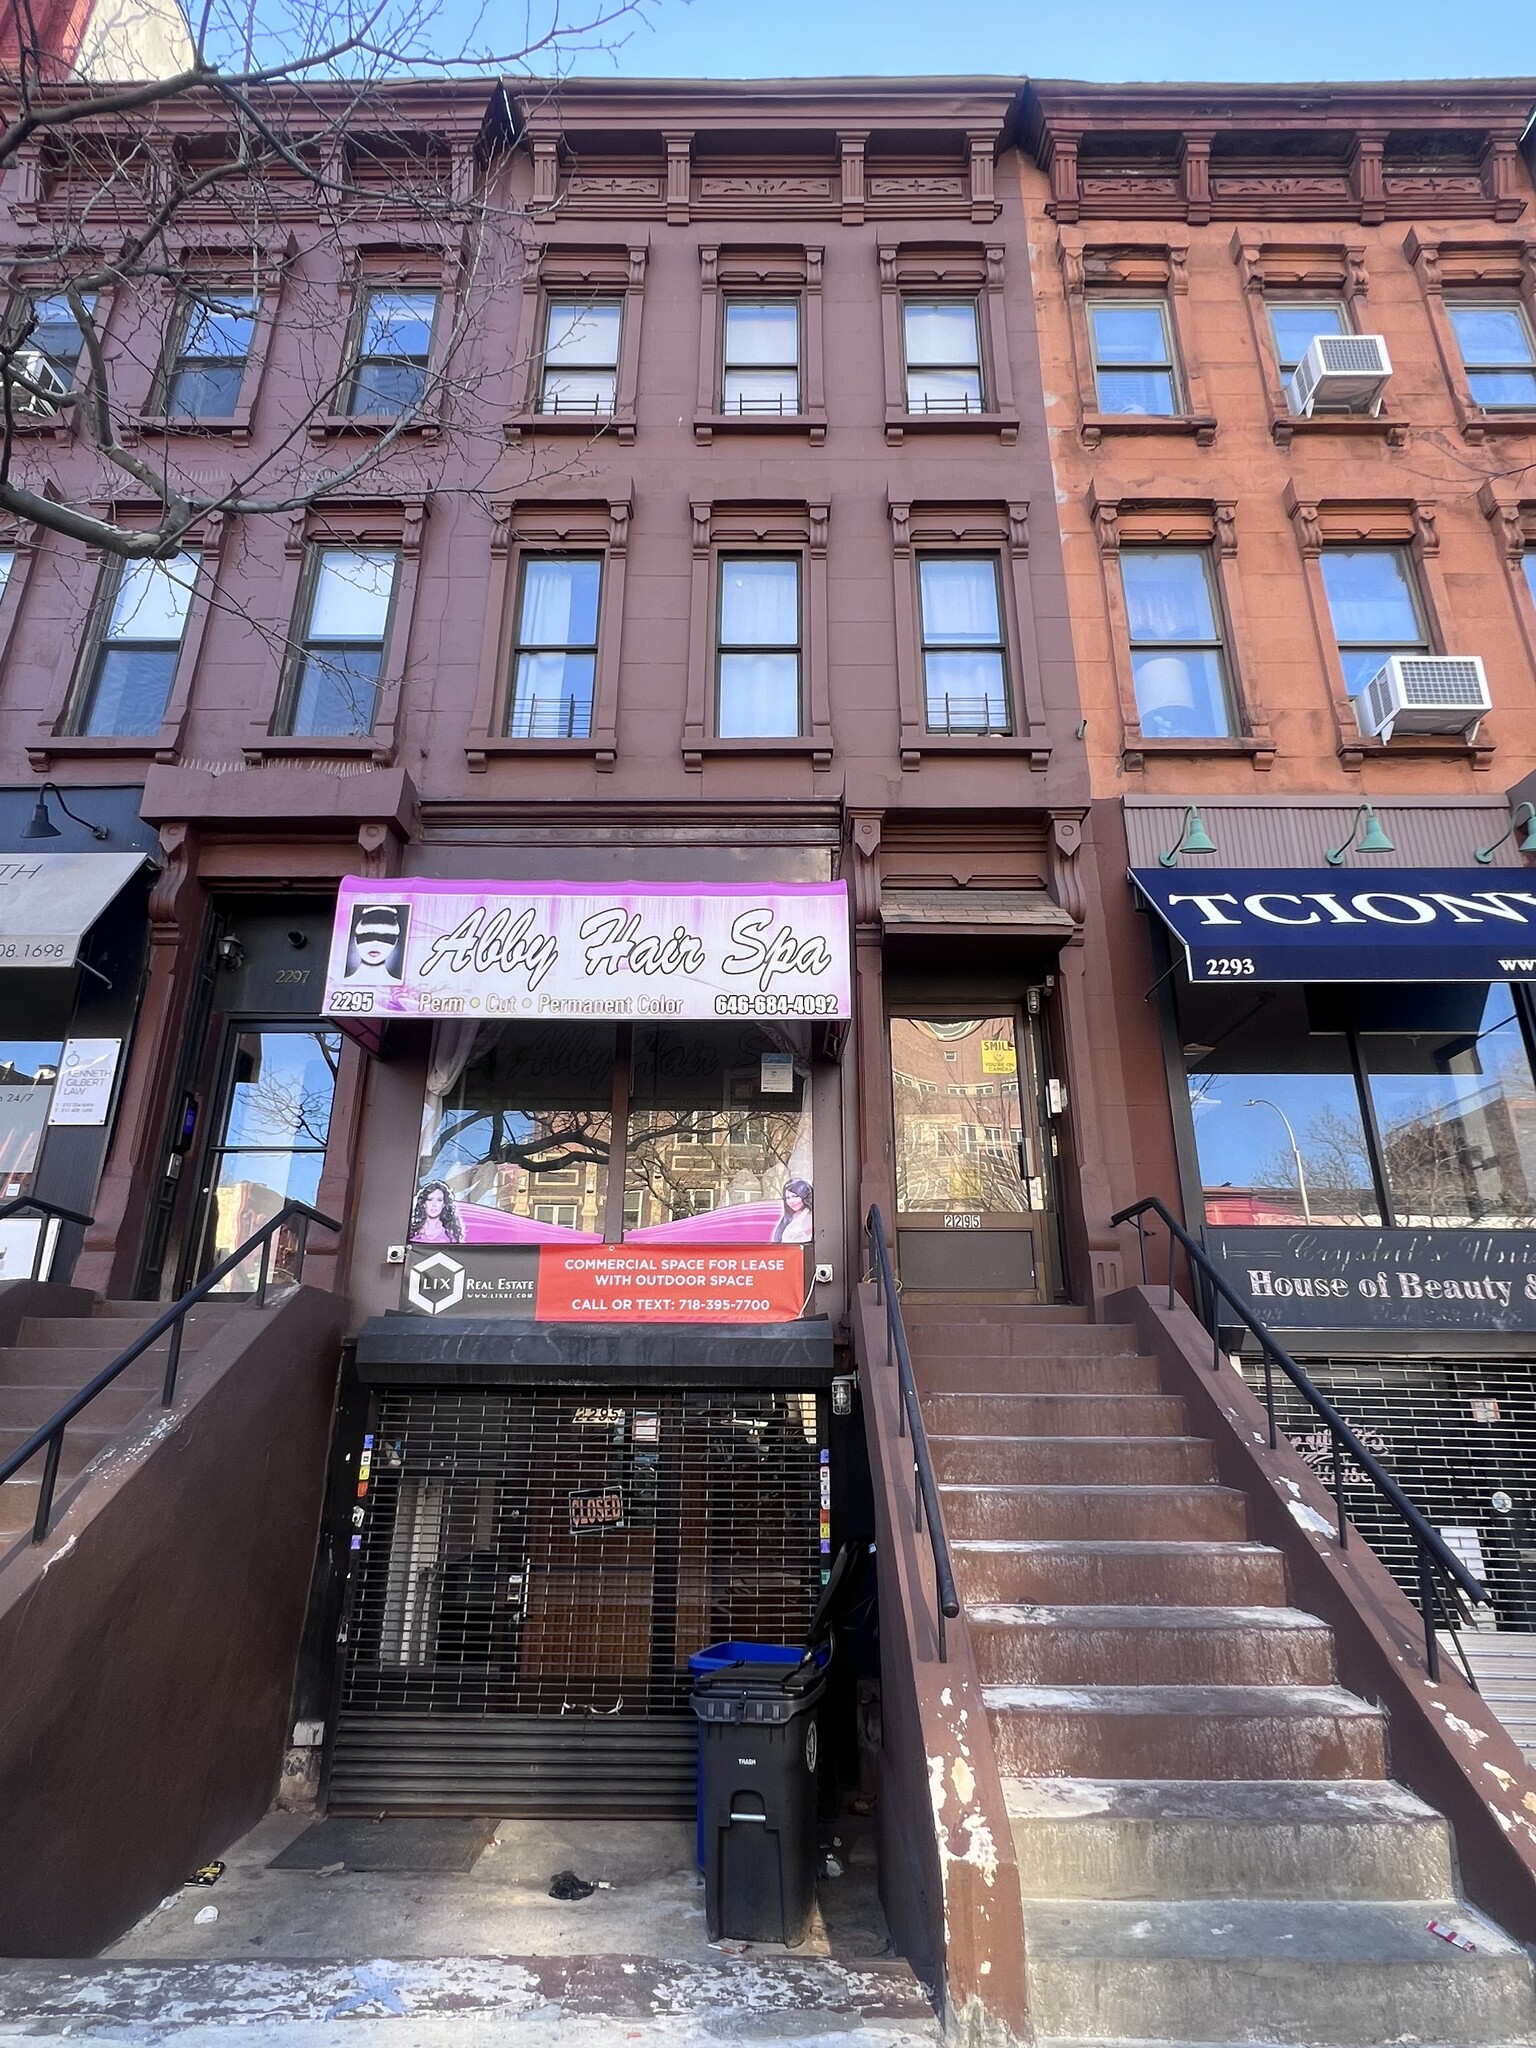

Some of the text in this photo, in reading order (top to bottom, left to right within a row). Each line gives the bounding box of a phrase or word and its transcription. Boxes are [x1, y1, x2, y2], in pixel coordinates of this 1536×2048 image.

[419, 906, 832, 992] Abby Hair Spa
[1205, 958, 1255, 976] 2293
[275, 970, 310, 983] 2297
[330, 991, 374, 1012] 2295
[418, 992, 684, 1014] Perm Cut Permanent Color
[714, 994, 839, 1015] 646-684-4092
[67, 1069, 112, 1078] KENNETH
[66, 1078, 105, 1087] GILBERT
[63, 1087, 86, 1095] LAW
[7, 1093, 34, 1103] 24/7
[945, 1215, 980, 1228] 2295
[565, 1259, 784, 1271] COMMERCIAL SPACE FOR LEASE
[423, 1278, 451, 1290] LIX
[595, 1275, 754, 1286] WITH OUTDOOR SPACE
[1247, 1270, 1350, 1298] House
[1358, 1271, 1390, 1299] of
[1396, 1272, 1512, 1307] Beauty
[571, 1299, 770, 1311] CALL OR TEXT: 718-395-7700
[574, 1408, 620, 1422] 2295
[571, 1494, 621, 1524] CLOSED
